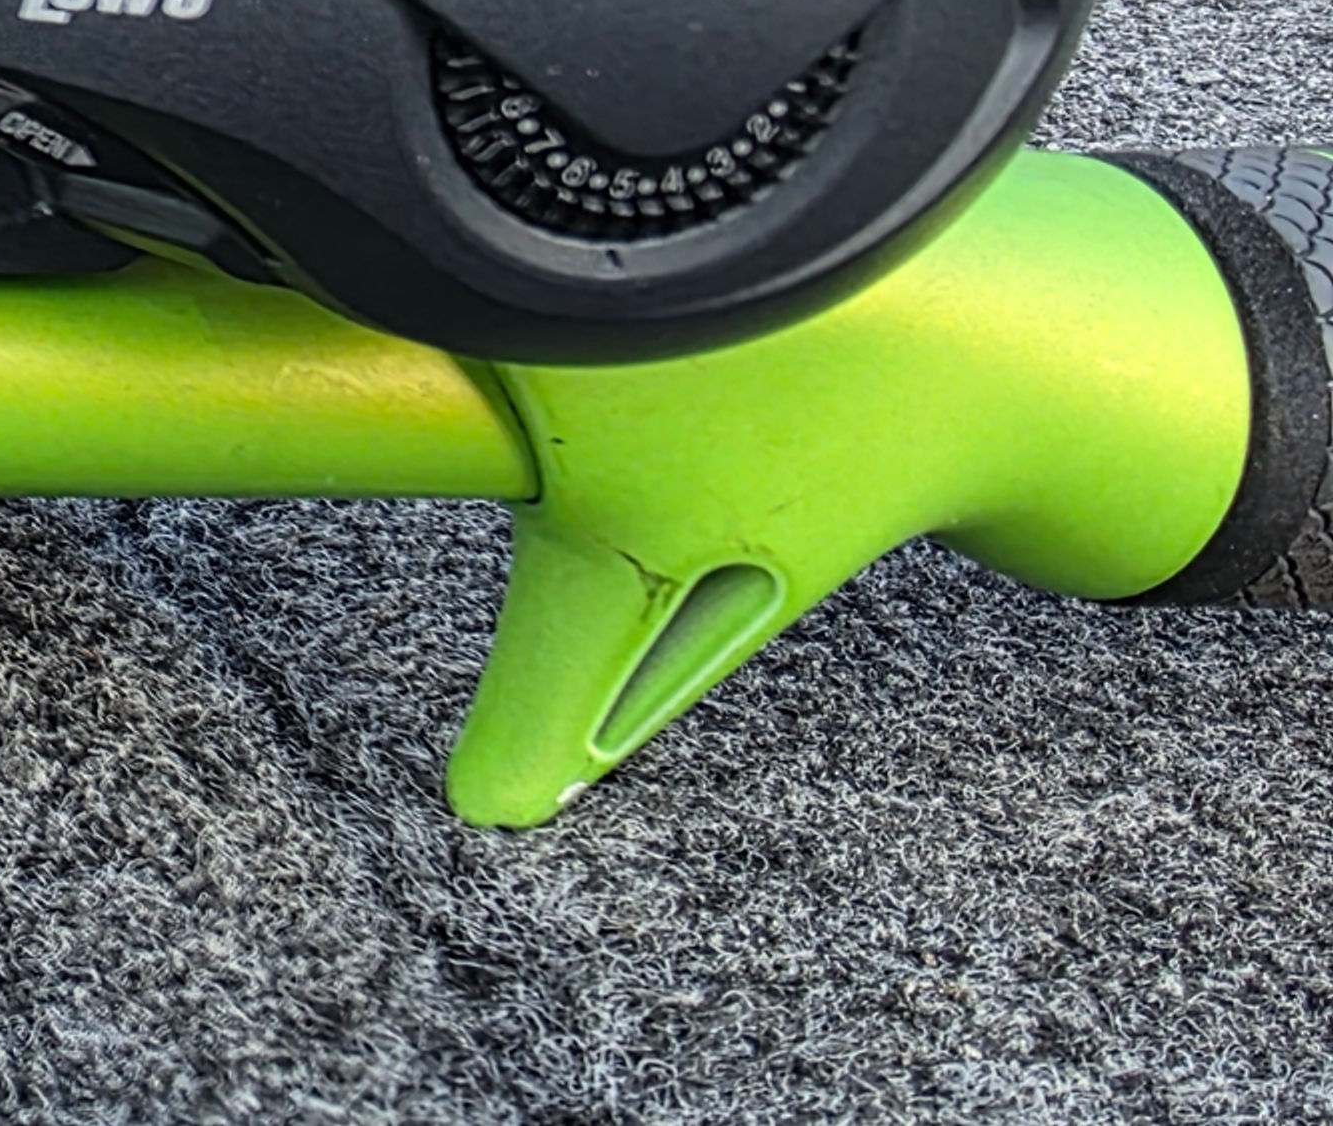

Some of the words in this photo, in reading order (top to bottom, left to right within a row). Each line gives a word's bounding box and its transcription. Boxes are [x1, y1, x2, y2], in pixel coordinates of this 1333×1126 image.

[562, 157, 597, 187] 6
[609, 169, 640, 199] 5
[661, 166, 685, 194] 4
[706, 146, 735, 177] 3
[746, 114, 780, 143] 2
